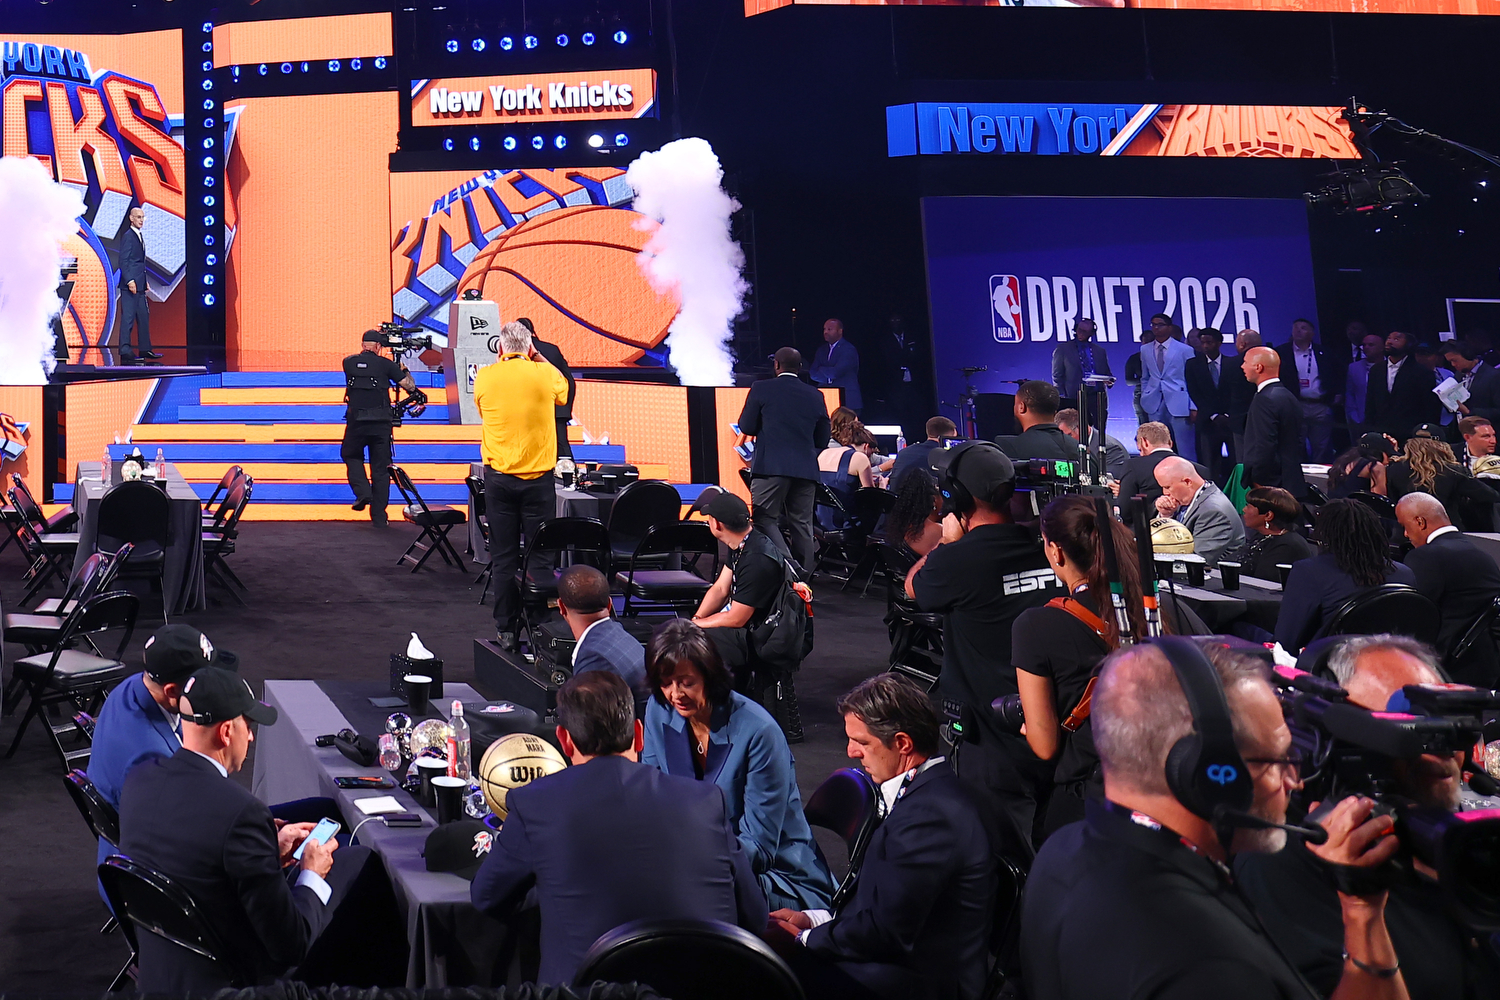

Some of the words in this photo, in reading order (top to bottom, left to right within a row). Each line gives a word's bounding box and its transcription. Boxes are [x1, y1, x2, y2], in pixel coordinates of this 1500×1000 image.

[3, 42, 92, 79] YORK
[429, 88, 483, 113] New
[488, 84, 542, 110] York
[548, 80, 634, 109] Knicks
[937, 106, 1035, 153] New
[1025, 276, 1146, 342] DRAFT
[1152, 276, 1261, 343] 2026
[997, 327, 1013, 339] NBA
[526, 744, 546, 753] MARA
